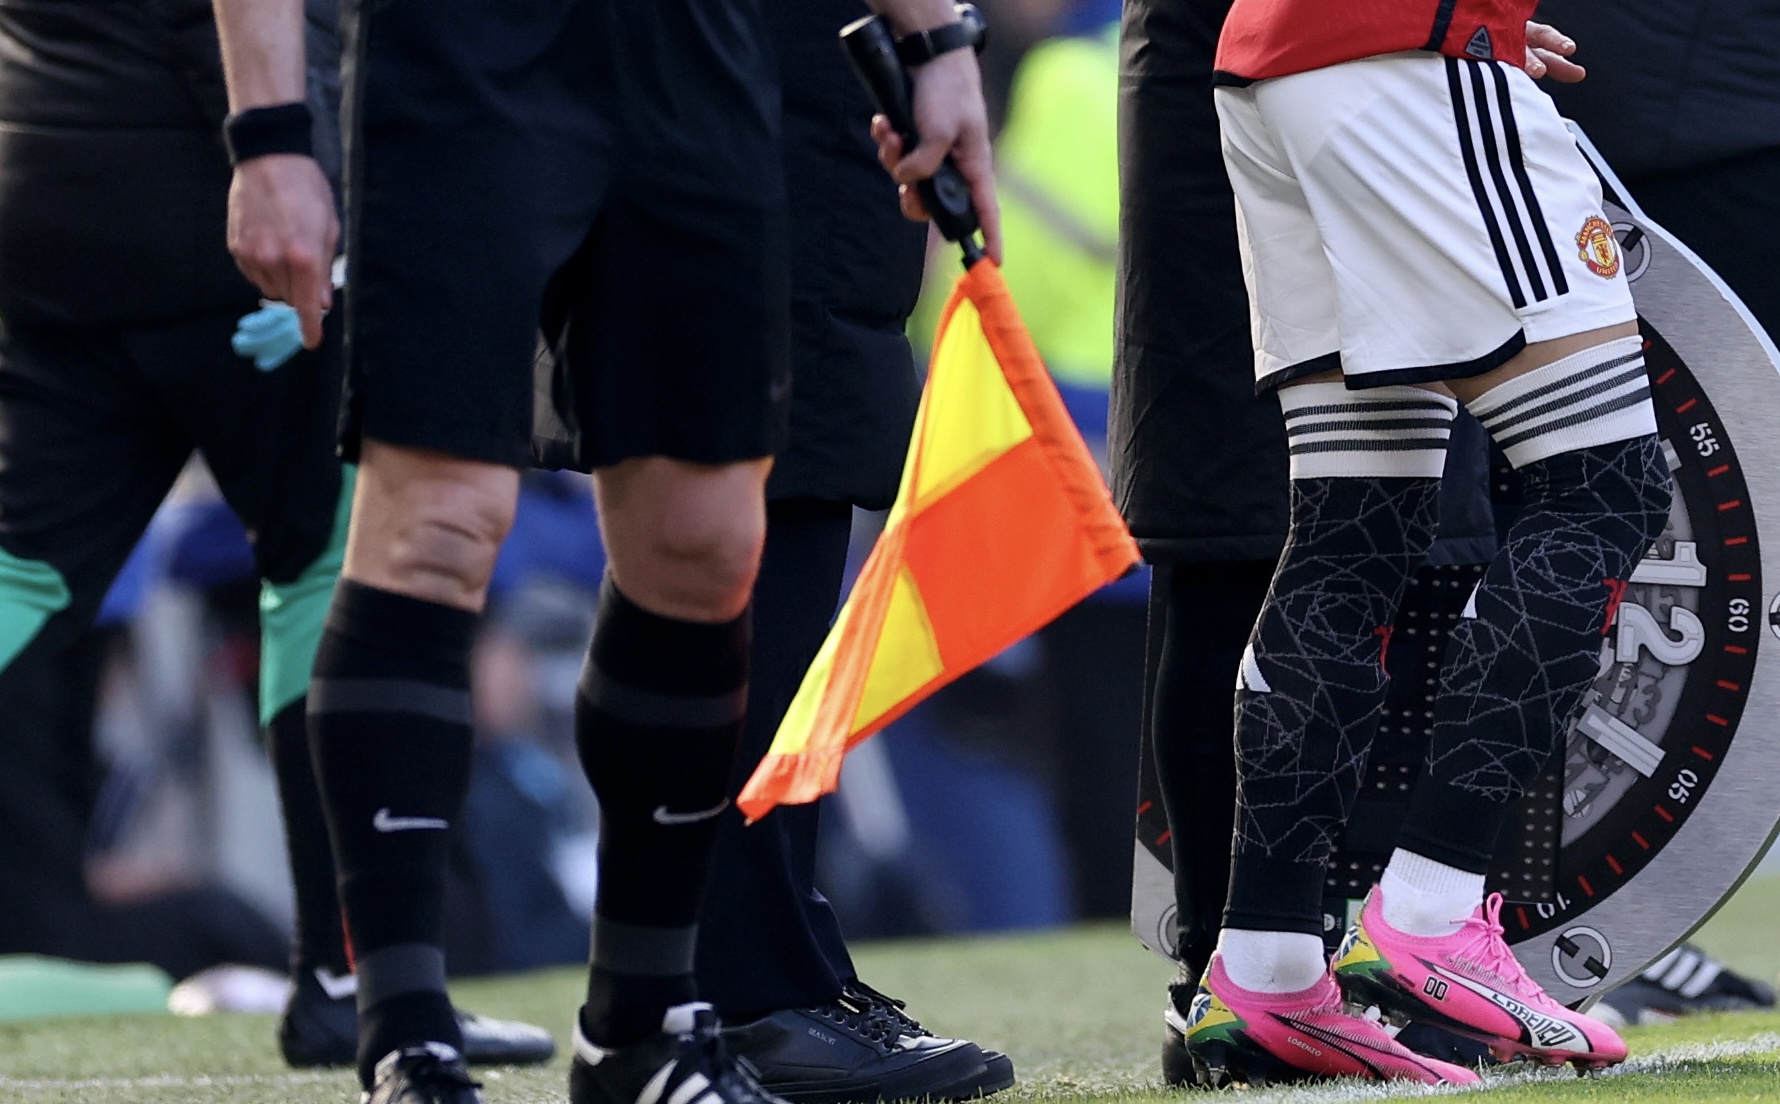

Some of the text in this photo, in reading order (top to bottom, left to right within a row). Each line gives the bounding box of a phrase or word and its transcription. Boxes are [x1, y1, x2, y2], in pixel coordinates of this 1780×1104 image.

[1689, 422, 1721, 457] 55
[1616, 541, 1708, 666] 12
[1727, 598, 1750, 633] 60
[1668, 769, 1698, 804] 05
